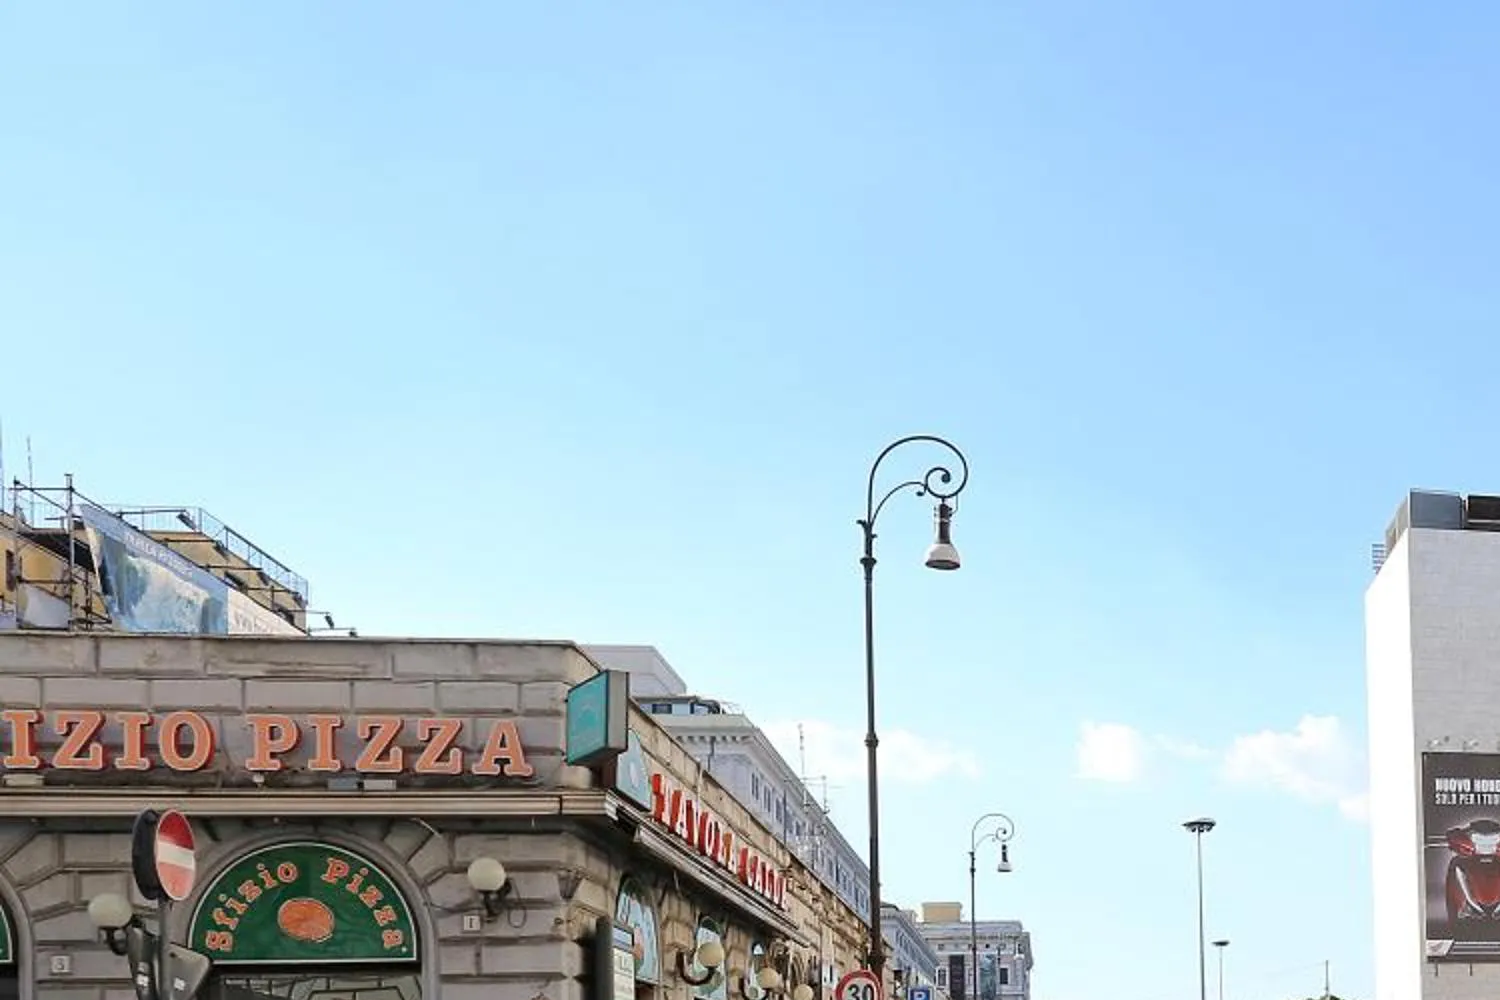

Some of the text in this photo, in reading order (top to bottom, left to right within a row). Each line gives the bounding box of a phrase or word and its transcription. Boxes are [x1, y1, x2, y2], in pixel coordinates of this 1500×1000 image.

[2, 709, 535, 777] IZIO PIZZA
[1435, 778, 1471, 792] NUOVO
[1459, 793, 1474, 805] PER
